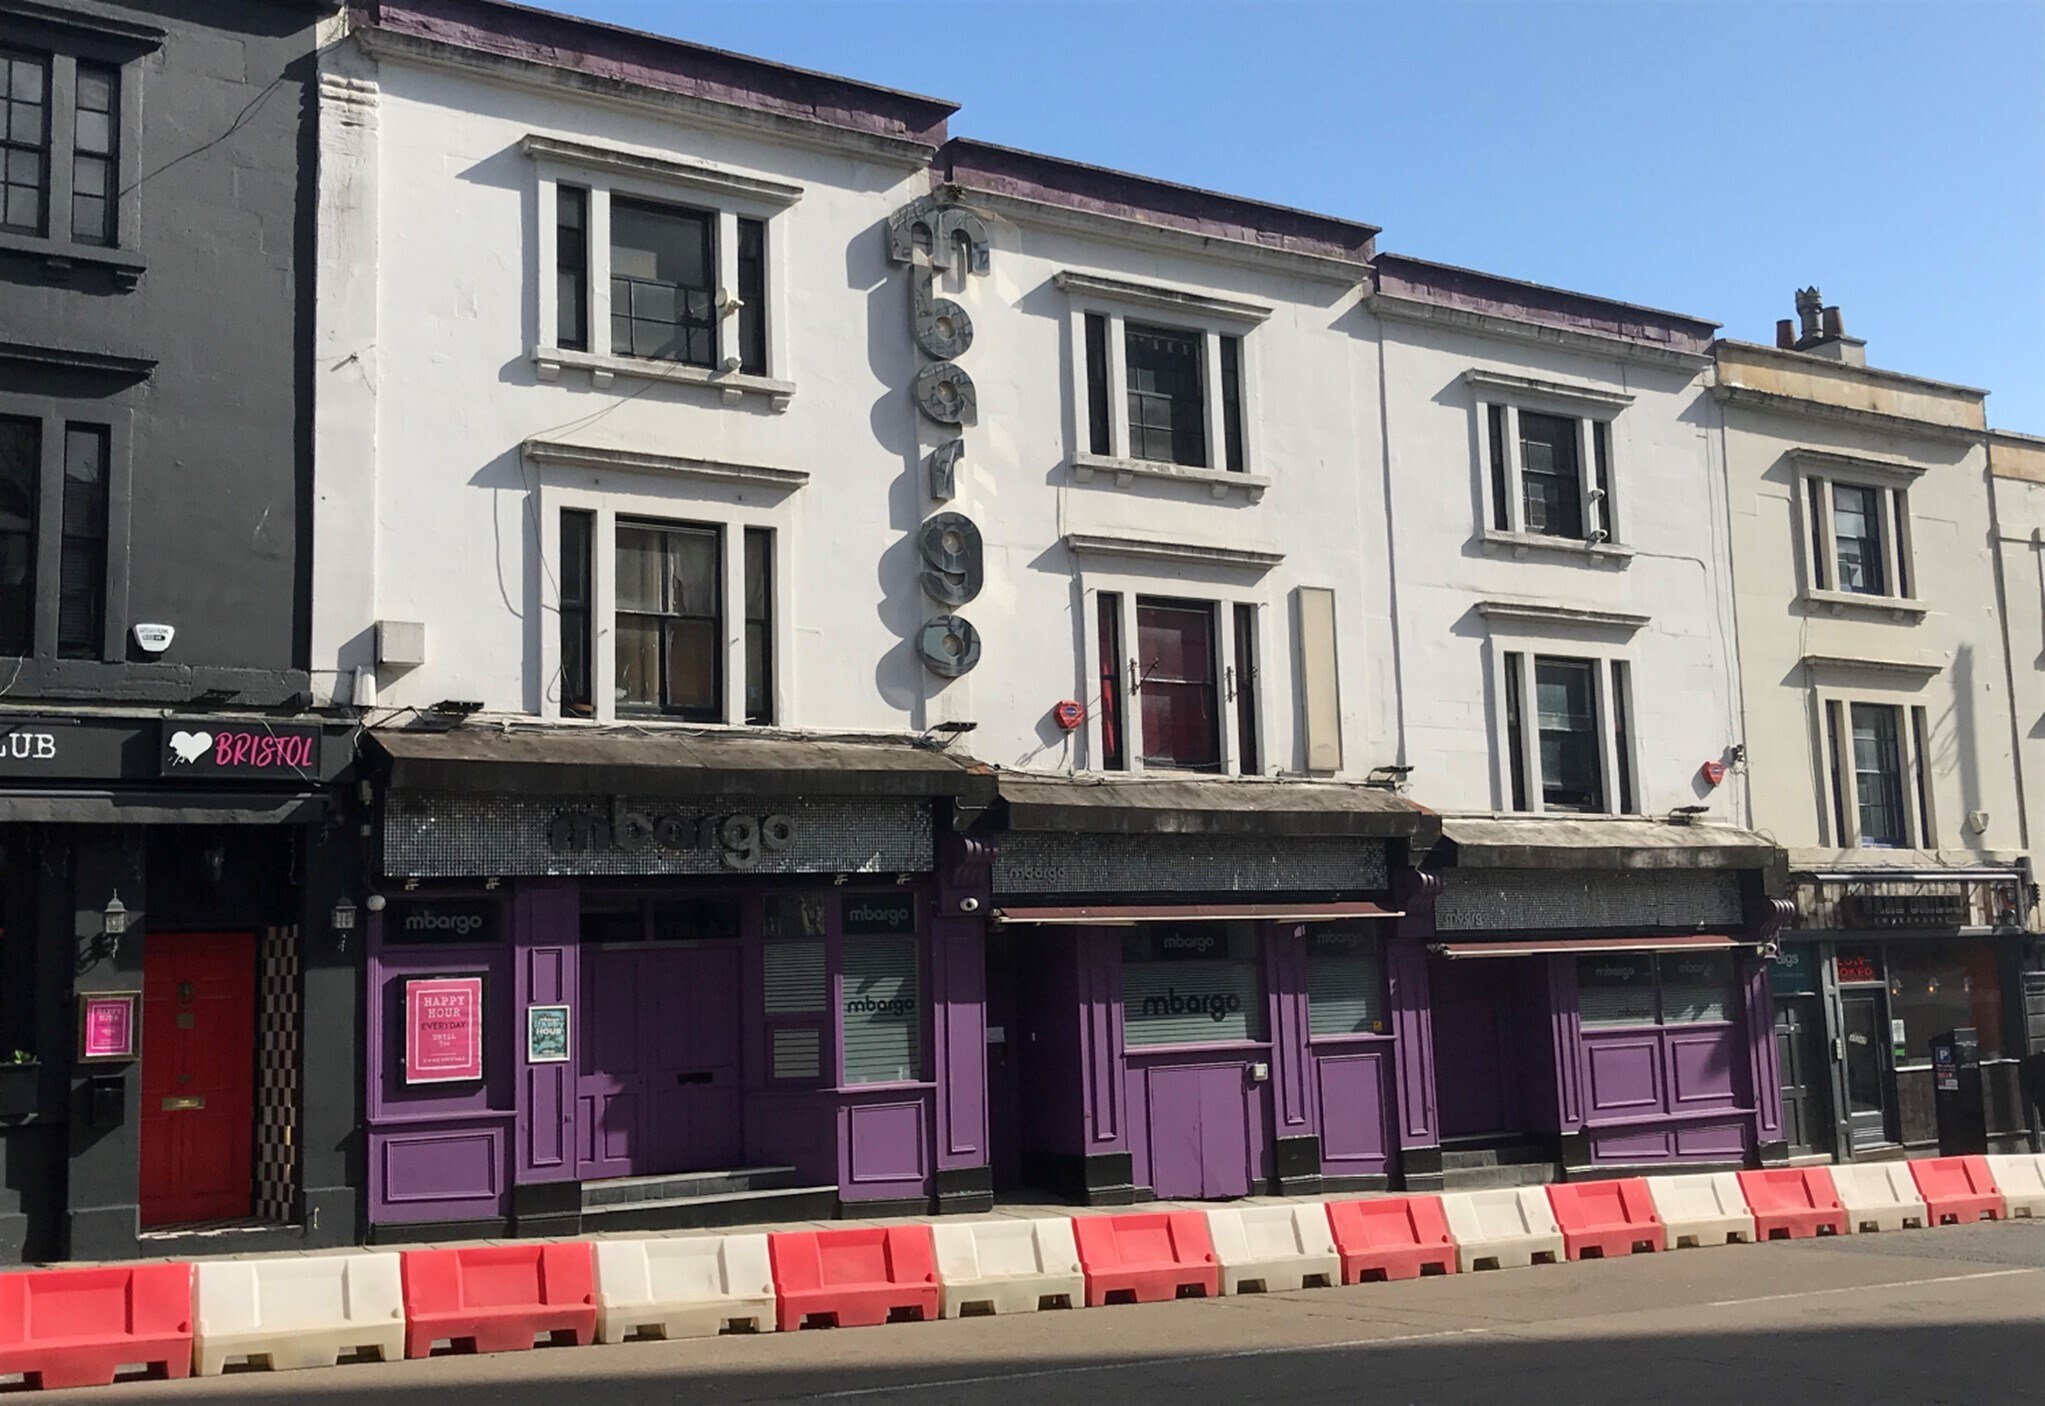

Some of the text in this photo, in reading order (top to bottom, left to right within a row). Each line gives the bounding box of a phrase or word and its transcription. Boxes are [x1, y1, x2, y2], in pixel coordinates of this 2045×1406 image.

[887, 204, 991, 679] mbargo
[215, 732, 313, 767] BRISTOL
[551, 794, 798, 870] mbargo
[406, 910, 482, 934] mbargo
[850, 904, 909, 926] mbargo
[1164, 932, 1214, 952] mbargo
[1317, 929, 1363, 947] mbargo
[1596, 962, 1635, 980] mbargo
[424, 996, 465, 1007] HAPPY
[847, 995, 914, 1016] mbargo
[1143, 987, 1240, 1022] mbargo
[428, 1008, 461, 1019] HOUR
[421, 1021, 466, 1031] EVERYDAY
[535, 1027, 562, 1036] HOUR
